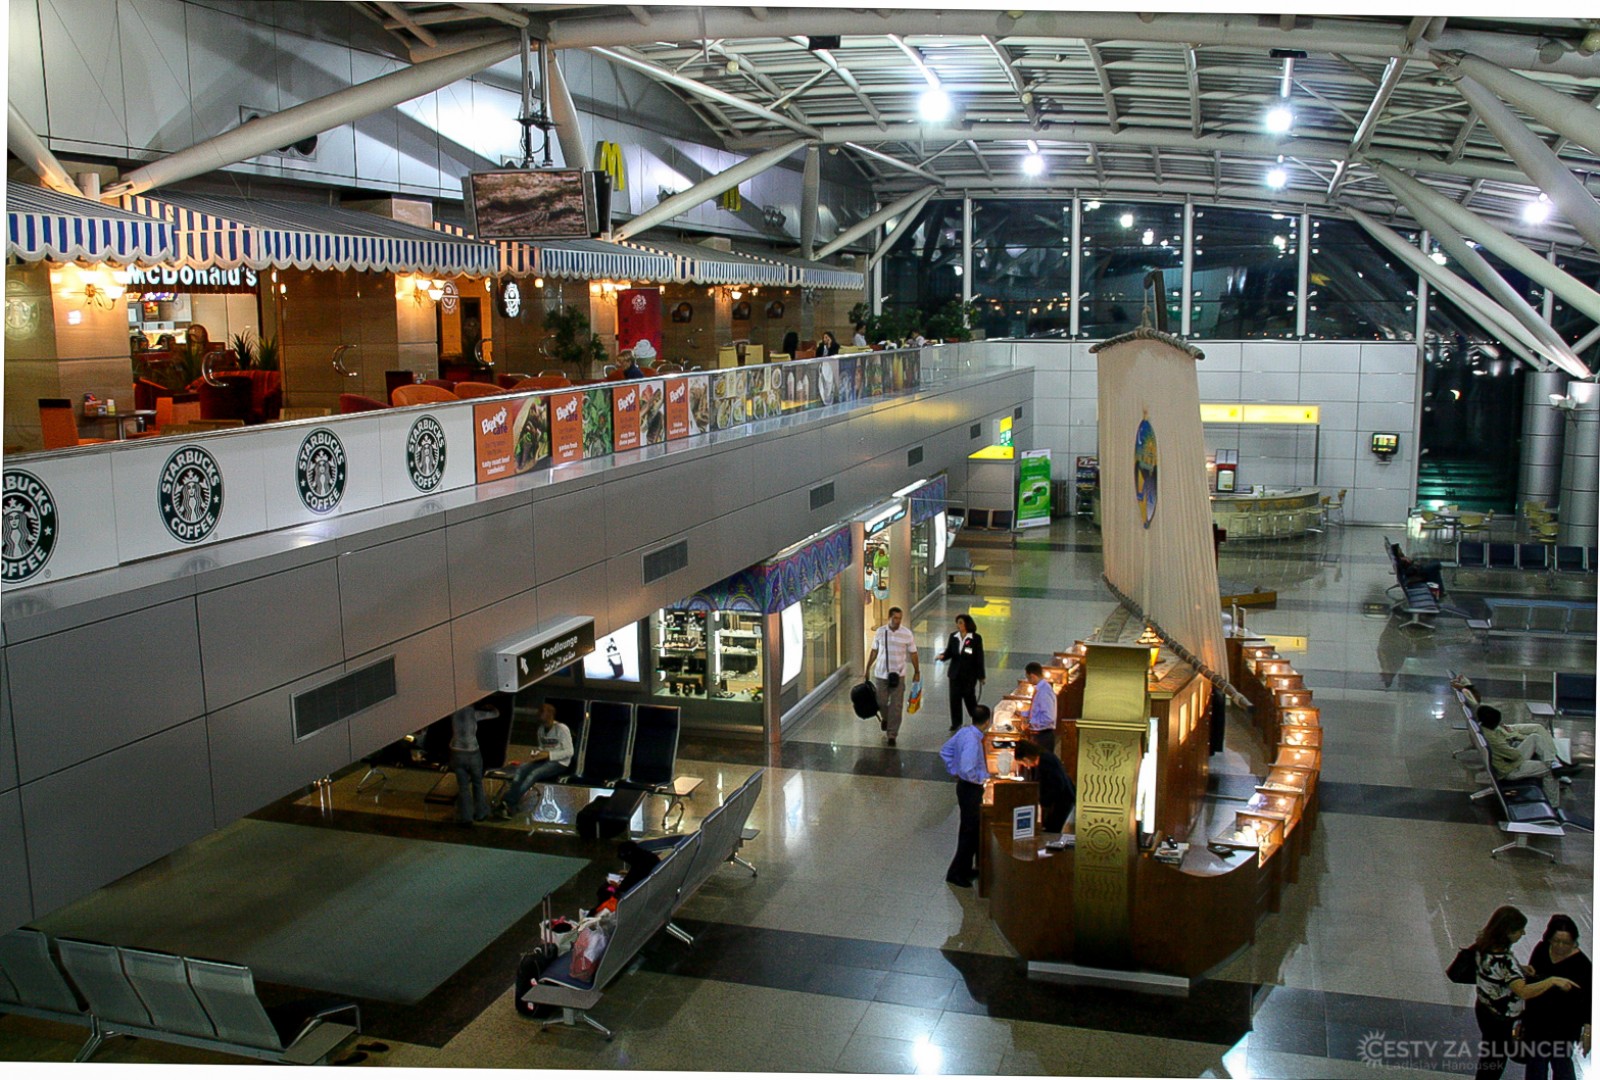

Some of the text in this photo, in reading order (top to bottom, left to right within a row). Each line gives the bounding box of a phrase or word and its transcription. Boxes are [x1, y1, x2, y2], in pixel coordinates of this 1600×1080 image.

[126, 263, 257, 287] McDonald's
[409, 419, 445, 453] STARBUCKS
[299, 433, 344, 471] STARBUCKS
[162, 450, 220, 494] STARBUCKS
[413, 468, 441, 489] COFFEE
[3, 475, 52, 516] BUCKS
[305, 487, 340, 510] COFFEE
[171, 511, 215, 538] COFFEE
[542, 636, 578, 660] Foodlounge
